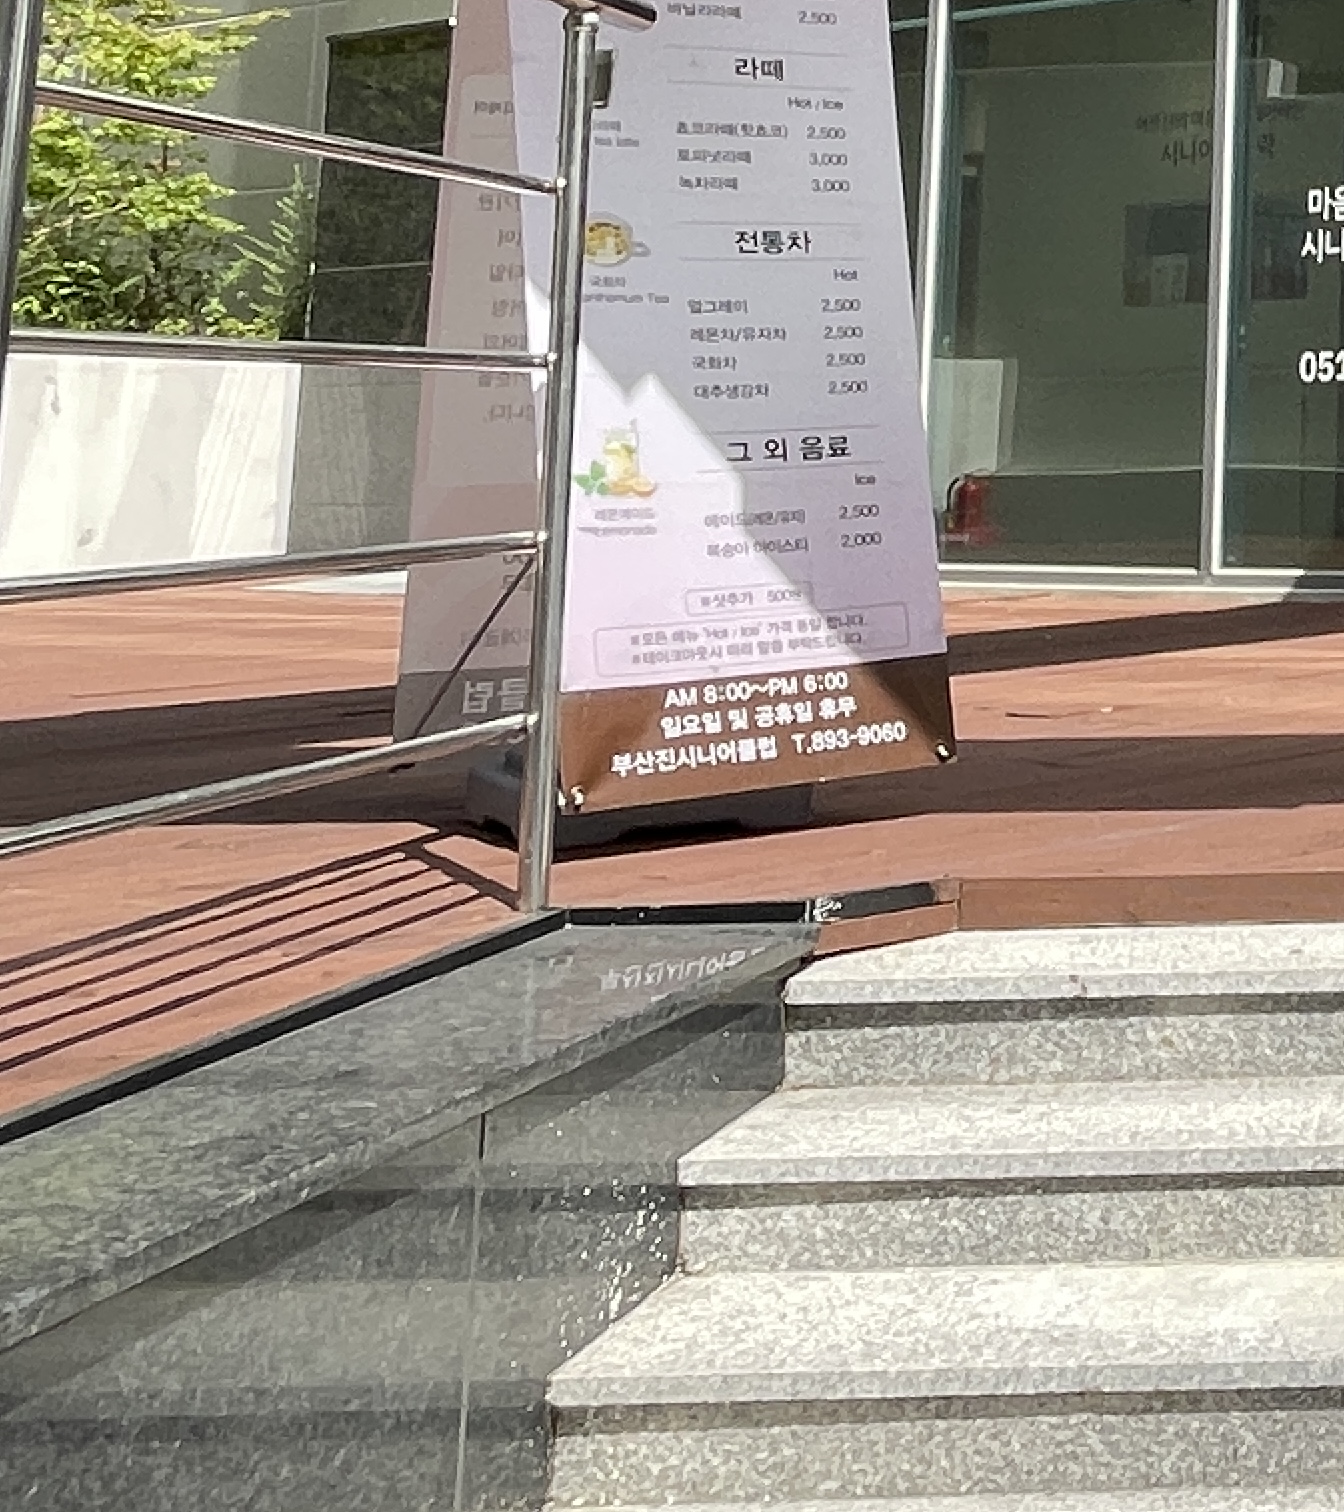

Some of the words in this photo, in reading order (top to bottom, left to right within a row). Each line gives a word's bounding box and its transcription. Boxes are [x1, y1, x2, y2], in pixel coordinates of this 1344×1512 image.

[734, 57, 784, 82] 라떼
[734, 230, 812, 254] 전통차
[725, 441, 754, 463] 그
[762, 436, 789, 463] 외
[799, 433, 852, 462] 음료
[664, 688, 698, 708] AM
[803, 671, 849, 694] 6:00
[660, 712, 722, 740] 일요일
[728, 709, 749, 731] 및
[755, 700, 814, 729] 공휴일
[818, 695, 858, 719] 휴무
[611, 735, 778, 778] 부산진시니어클럽
[791, 720, 907, 754] T.893-9060
